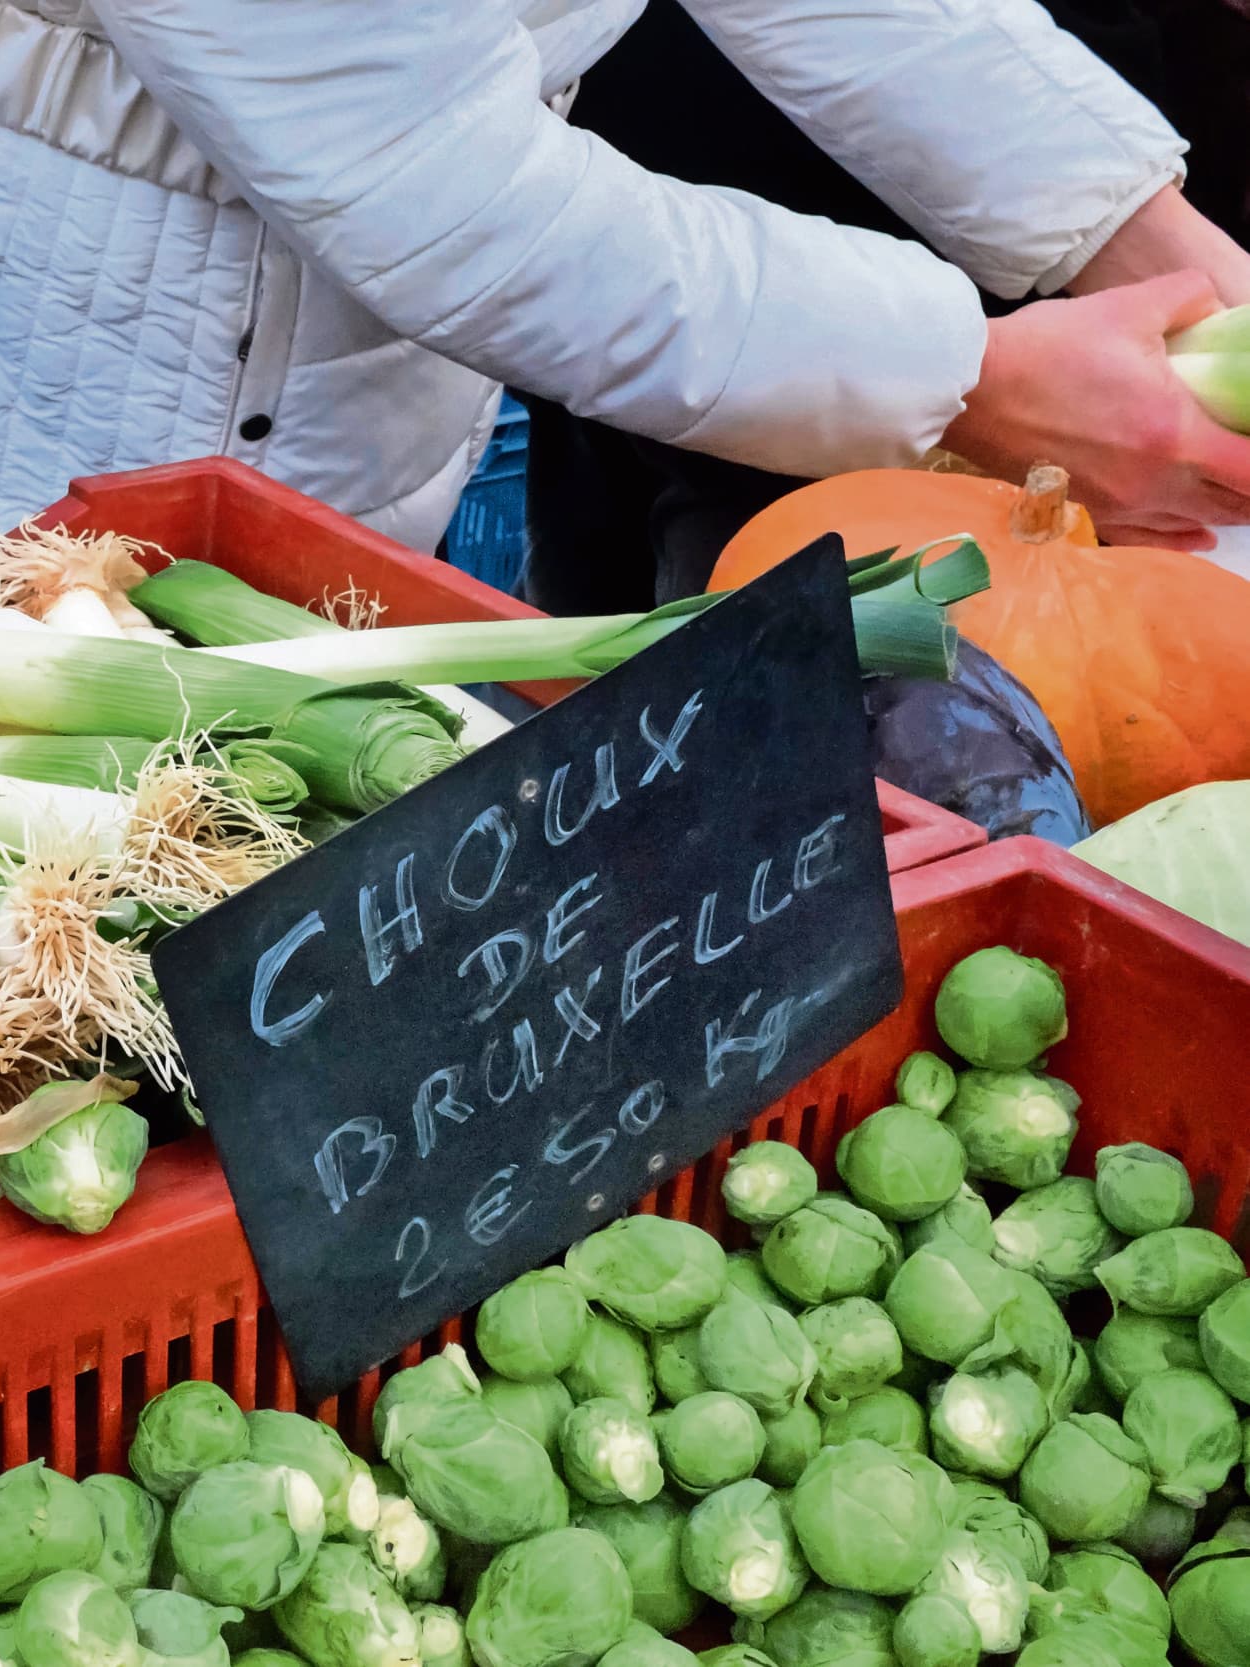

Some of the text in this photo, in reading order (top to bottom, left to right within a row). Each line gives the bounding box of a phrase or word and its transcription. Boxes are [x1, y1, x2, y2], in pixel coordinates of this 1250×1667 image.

[250, 690, 704, 1046] CHOUX
[314, 815, 846, 1213] BRUXELLE
[457, 872, 603, 1022] DE
